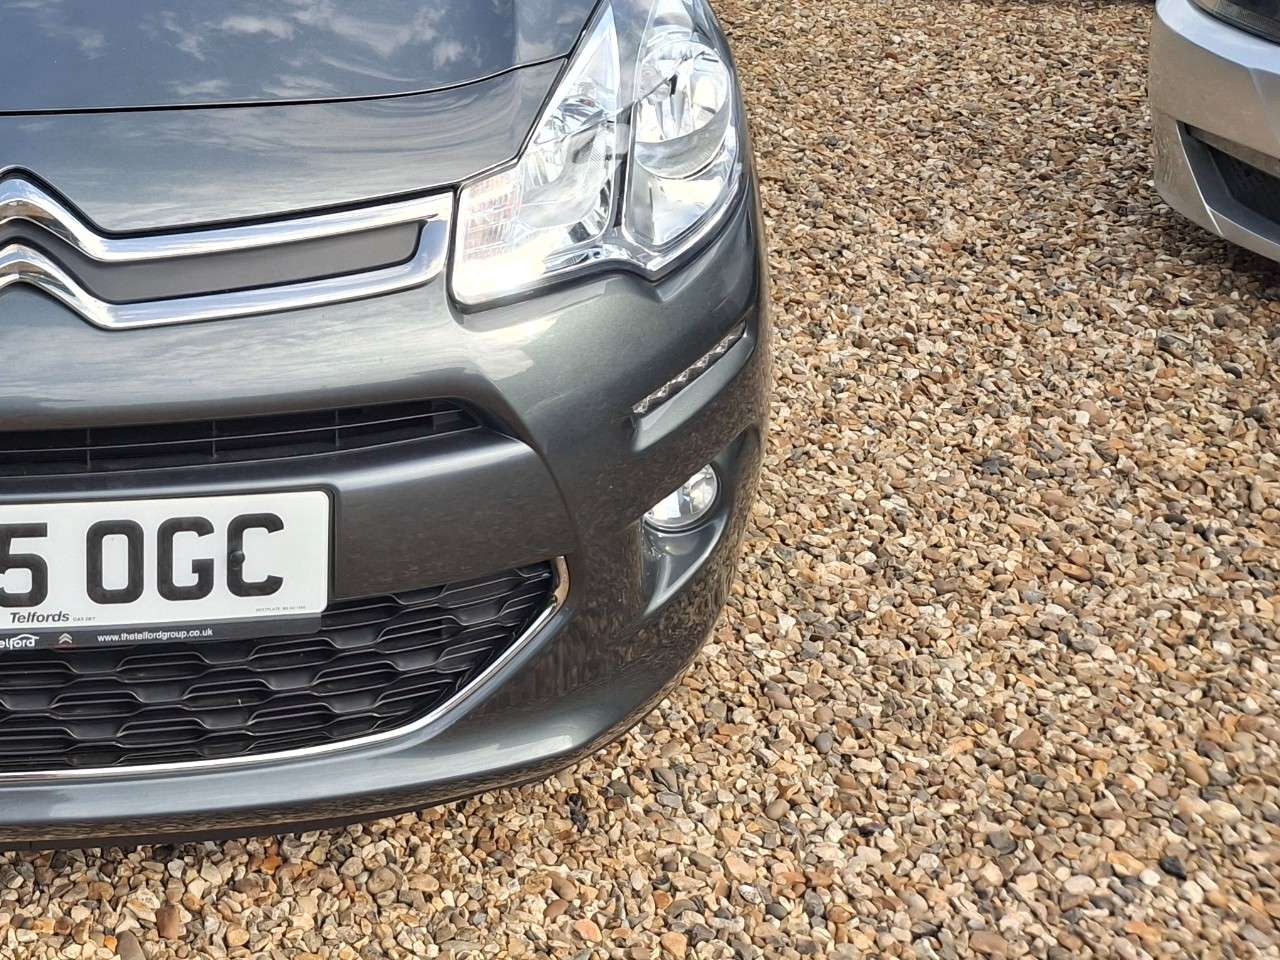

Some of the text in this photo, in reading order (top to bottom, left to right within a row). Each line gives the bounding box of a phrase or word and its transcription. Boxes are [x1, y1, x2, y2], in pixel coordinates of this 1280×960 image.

[85, 513, 284, 605] OGC
[10, 610, 70, 624] Telfords
[97, 628, 213, 642] www.thetelfordgroup.co.uk
